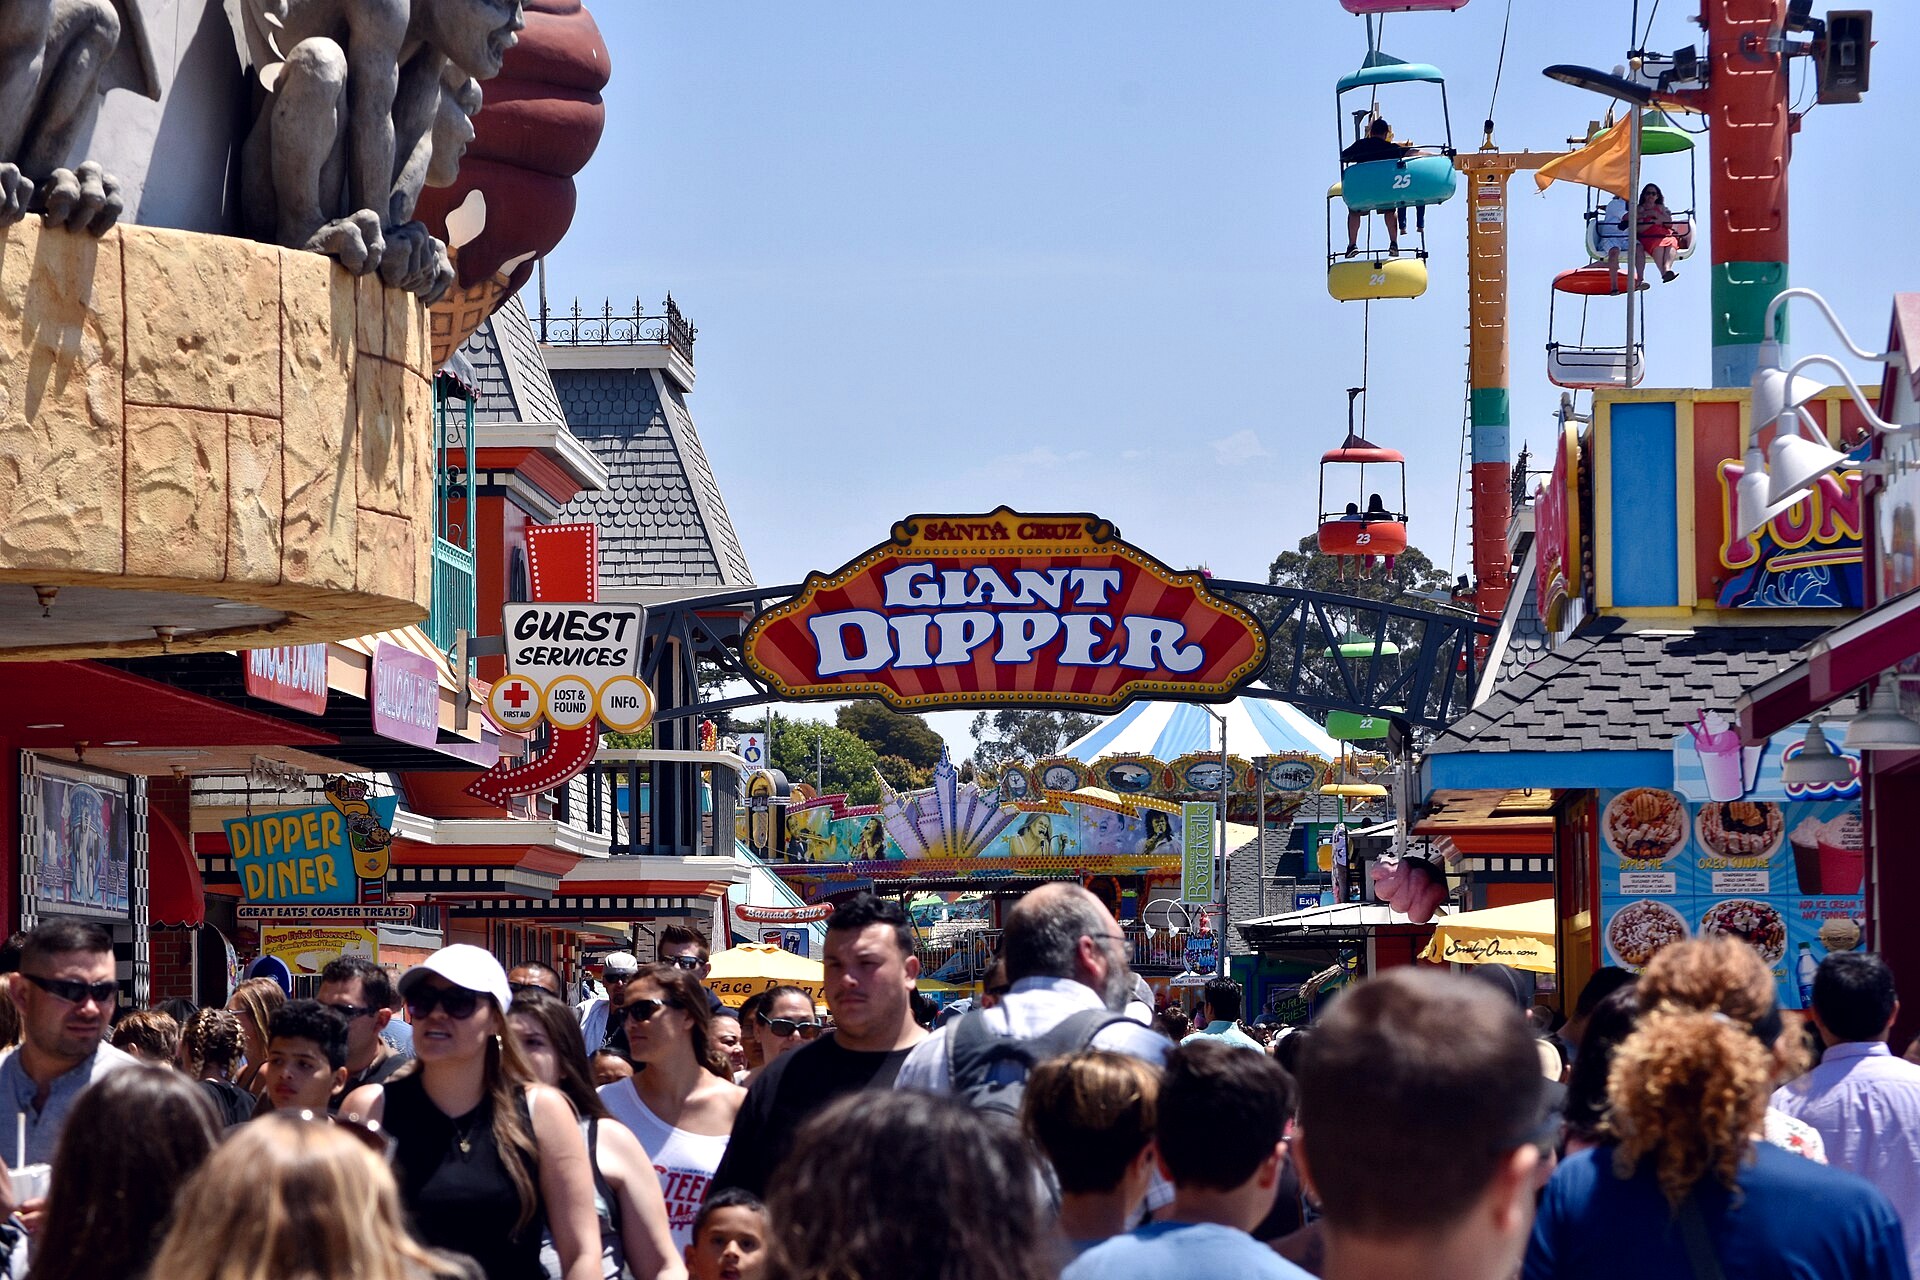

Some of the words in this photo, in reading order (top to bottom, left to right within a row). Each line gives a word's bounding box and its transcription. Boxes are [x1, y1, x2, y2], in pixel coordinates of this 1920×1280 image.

[1392, 174, 1411, 189] 25
[1369, 273, 1386, 287] 24
[924, 519, 1011, 541] SANTA
[1017, 522, 1083, 541] CRUZ
[1356, 533, 1371, 546] 23
[883, 562, 1123, 609] GIANT
[513, 609, 636, 642] GUEST
[809, 609, 1206, 678] DIPPER
[515, 646, 628, 667] SERVICES
[554, 690, 577, 701] LOST
[578, 690, 585, 700] &
[610, 695, 640, 709] INFO.
[554, 702, 586, 713] FOUND
[1360, 719, 1373, 729] 22
[230, 810, 342, 859] DIPPER
[1188, 805, 1210, 901] Boardwalk
[1619, 859, 1645, 870] APPLE
[1698, 858, 1728, 869] OREO
[1731, 857, 1769, 869] SUNDAE
[245, 853, 338, 899] DINER
[1299, 897, 1317, 906] Exit
[238, 907, 273, 917] GREAT
[277, 907, 308, 917] EATS!
[311, 907, 361, 917] COASTER
[363, 907, 409, 917] TREATS!
[746, 908, 794, 919] Barnacle
[796, 908, 826, 919] Bill's
[1821, 911, 1850, 920] FUNNEL
[264, 934, 287, 945] Deep
[288, 930, 313, 942] Fried
[313, 929, 362, 941] Cheesecake
[710, 980, 752, 994] Face
